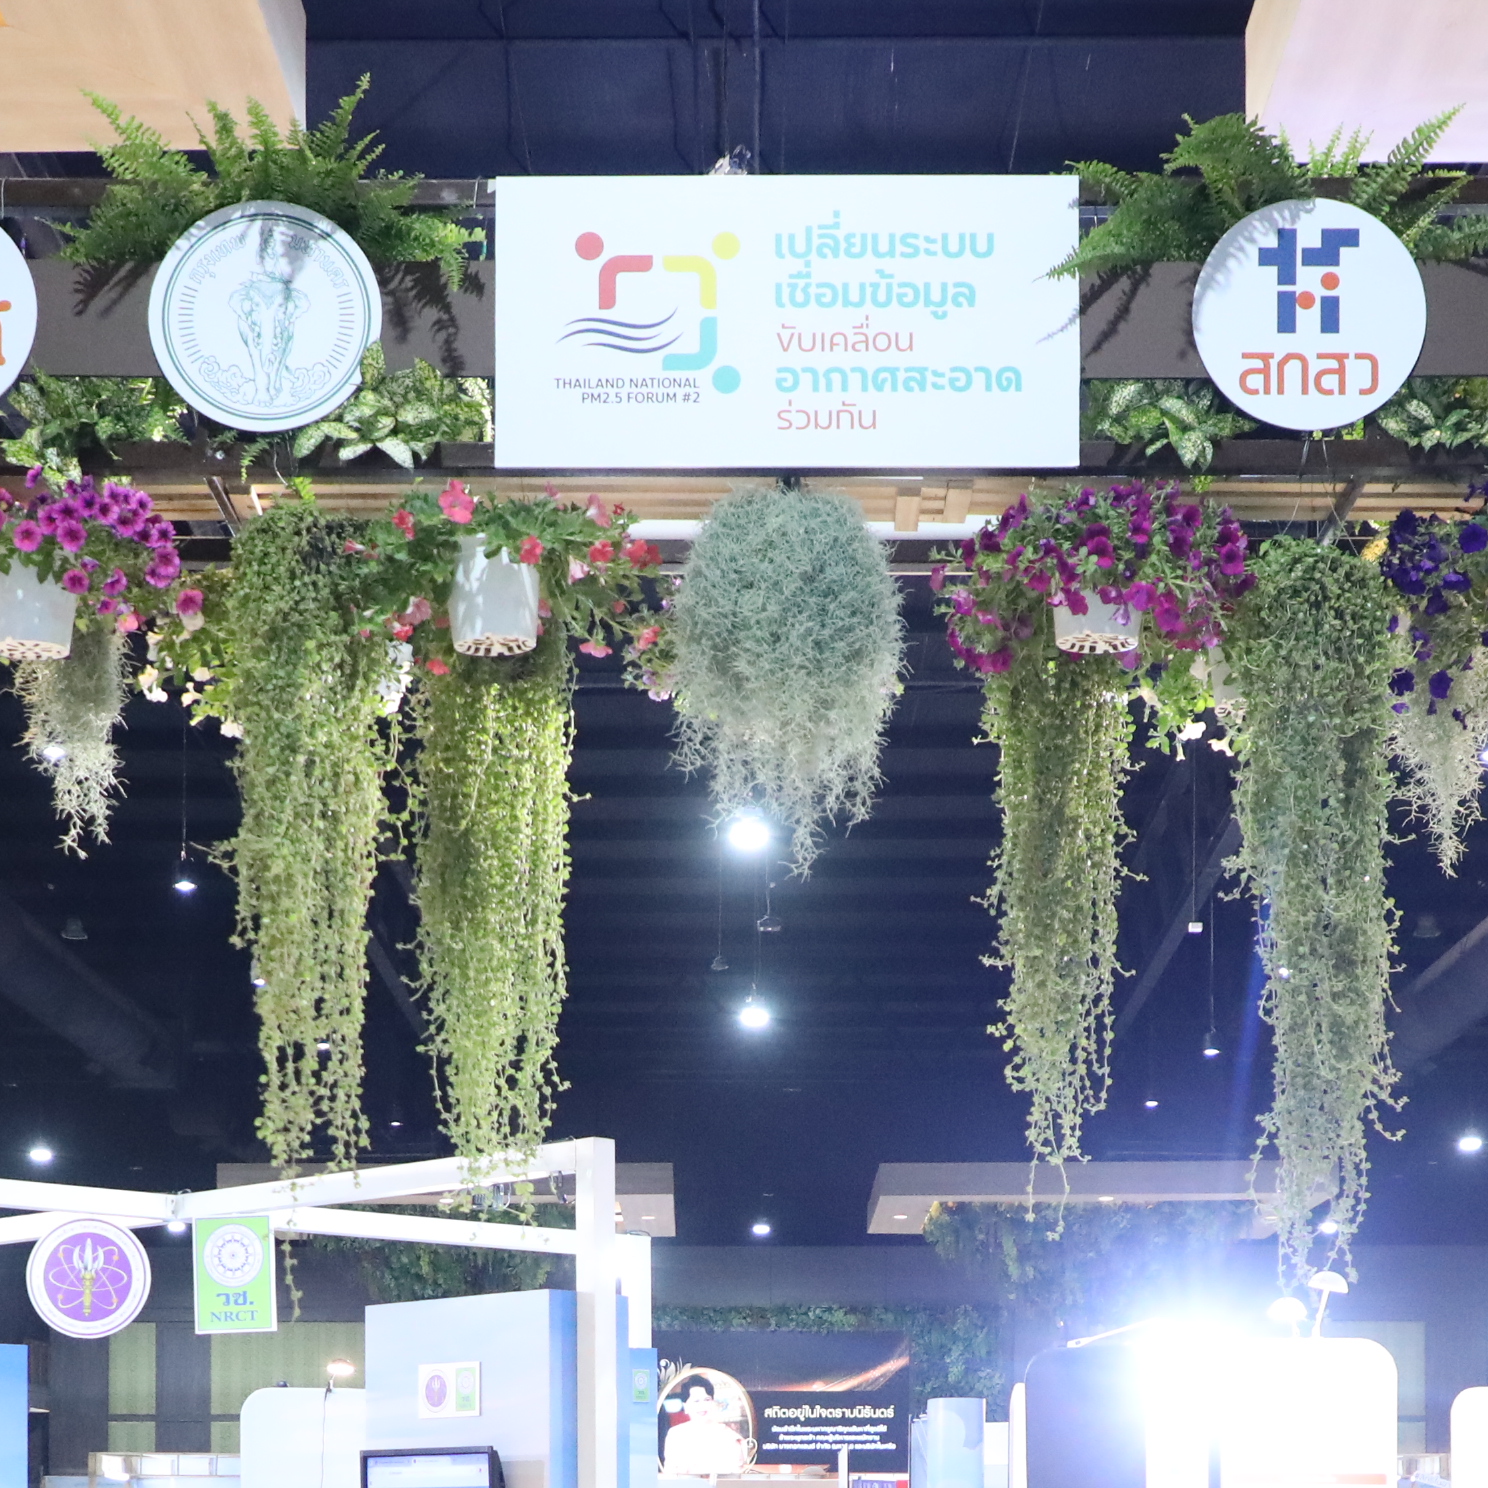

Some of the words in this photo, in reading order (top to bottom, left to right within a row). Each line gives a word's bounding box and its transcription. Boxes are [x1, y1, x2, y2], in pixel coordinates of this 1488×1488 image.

[774, 210, 995, 260] เปลี่ยนระบบ
[774, 260, 976, 320] เชื่อมข้อมูล
[776, 315, 914, 354] ขับเคลื่อน
[554, 378, 625, 389] THAILAND
[630, 377, 700, 389] NATIONAL
[774, 363, 1023, 394] อากาศสะอาด
[1239, 351, 1380, 395] สกสว
[582, 392, 623, 404] PM2.5
[627, 392, 677, 403] FORUM
[682, 391, 700, 403] #2
[776, 400, 877, 431] ร่วมกัน
[216, 1291, 254, 1306] วช.
[210, 1310, 258, 1322] NRCT
[764, 1405, 895, 1421] สถิตอยู่ในใจตราบนิรันดร์
